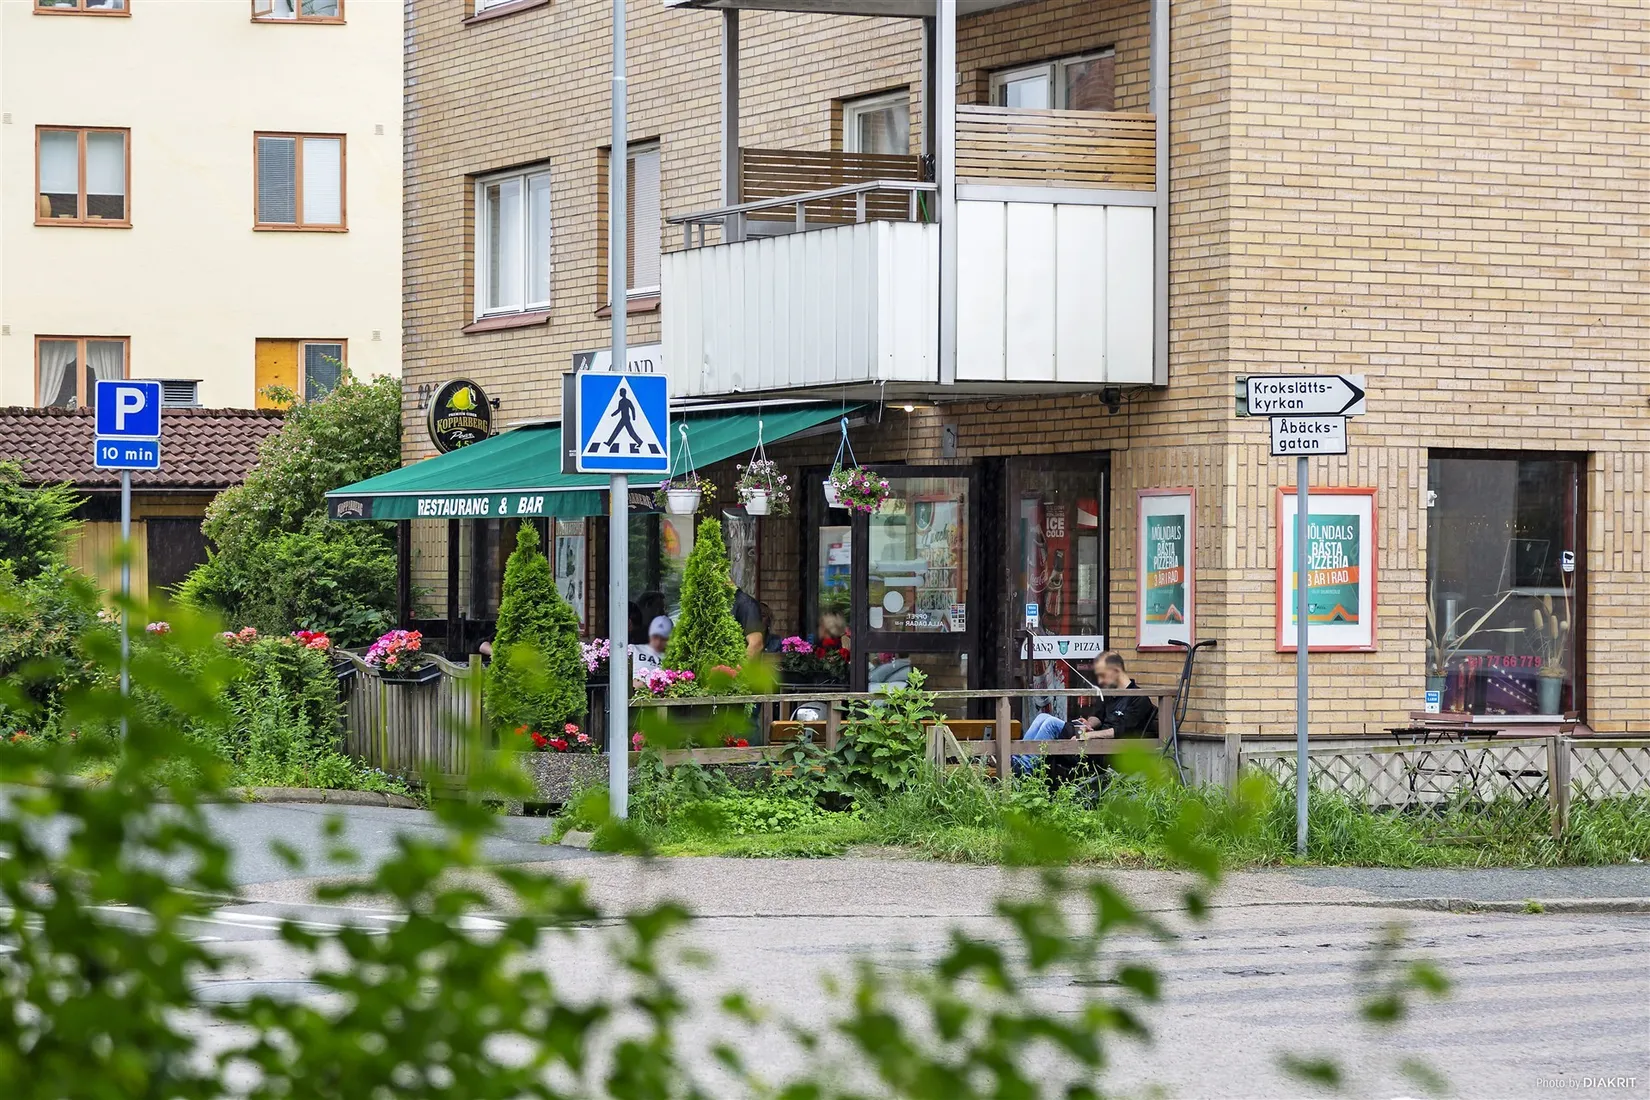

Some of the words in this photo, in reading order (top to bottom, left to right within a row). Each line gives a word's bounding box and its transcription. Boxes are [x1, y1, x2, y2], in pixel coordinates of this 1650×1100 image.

[1254, 381, 1333, 394] Krokslätts-
[115, 387, 146, 431] P
[1255, 397, 1304, 412] kyrkan
[437, 416, 488, 434] KOPPARBERG
[1279, 418, 1338, 434] Åbäcks-
[1279, 438, 1319, 452] gatan
[102, 447, 118, 460] 10
[125, 446, 153, 460] min
[418, 496, 489, 516] RESTAURANG
[498, 498, 508, 514] &
[518, 496, 544, 514] BAR
[1046, 518, 1065, 530] ICE
[1308, 523, 1354, 540] ÖLNDALS
[1152, 525, 1182, 541] MÖLNDALS
[1157, 540, 1175, 556] BÄSTA
[1312, 540, 1343, 556] BÄSTA
[1153, 554, 1178, 570] PIZZERIA
[1167, 570, 1178, 584] RAD
[1314, 570, 1326, 585] ÅR
[1332, 570, 1349, 584] RAD
[1074, 642, 1100, 652] PIZZA
[1503, 655, 1517, 668] 66
[1520, 655, 1542, 668] 779
